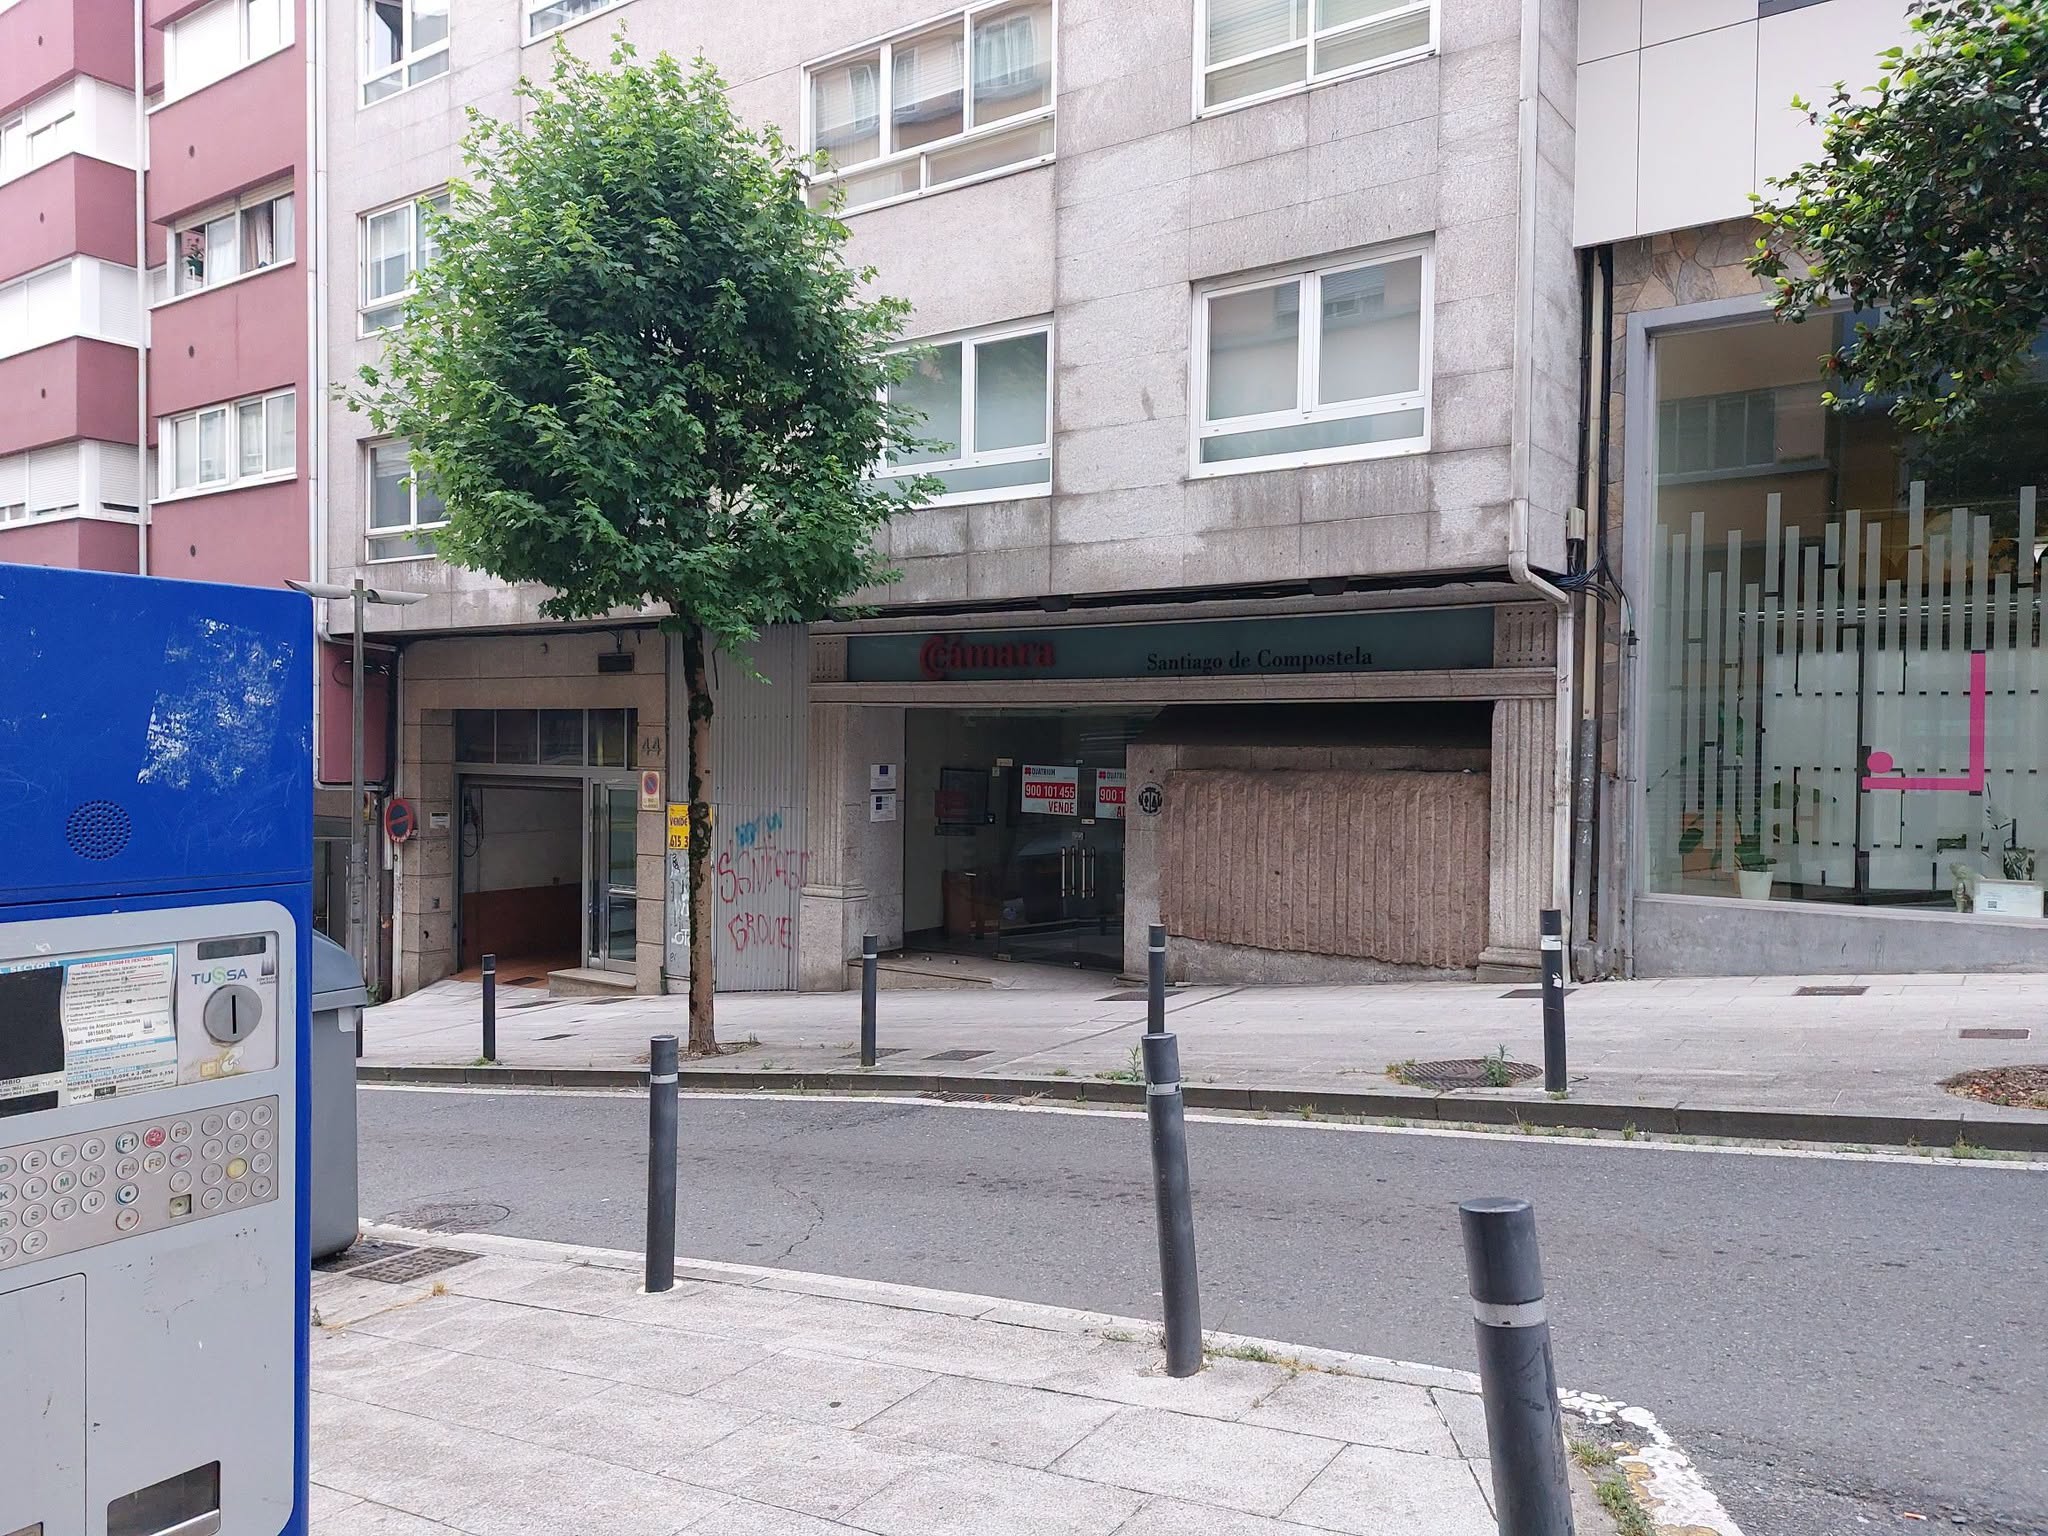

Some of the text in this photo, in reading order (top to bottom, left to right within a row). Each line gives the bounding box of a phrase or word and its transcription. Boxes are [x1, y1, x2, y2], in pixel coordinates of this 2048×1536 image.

[1147, 645, 1373, 673] Santiago de Compostela
[641, 737, 662, 755] 44
[1025, 784, 1075, 798] 900 101 455
[1100, 789, 1117, 800] 900
[1048, 801, 1075, 814] VENDE
[669, 816, 688, 826] VENDE
[670, 835, 682, 847] 615
[191, 966, 248, 985] TUSSA
[121, 1127, 188, 1148] F1 F3
[31, 1158, 39, 1167] E
[61, 1151, 68, 1160] F
[89, 1145, 98, 1155] G
[121, 1163, 135, 1174] F4
[0, 1172, 98, 1200] K L M N
[31, 1211, 39, 1220] S
[61, 1203, 68, 1213] T
[89, 1197, 98, 1207] U
[0, 1238, 39, 1255] Y Z
